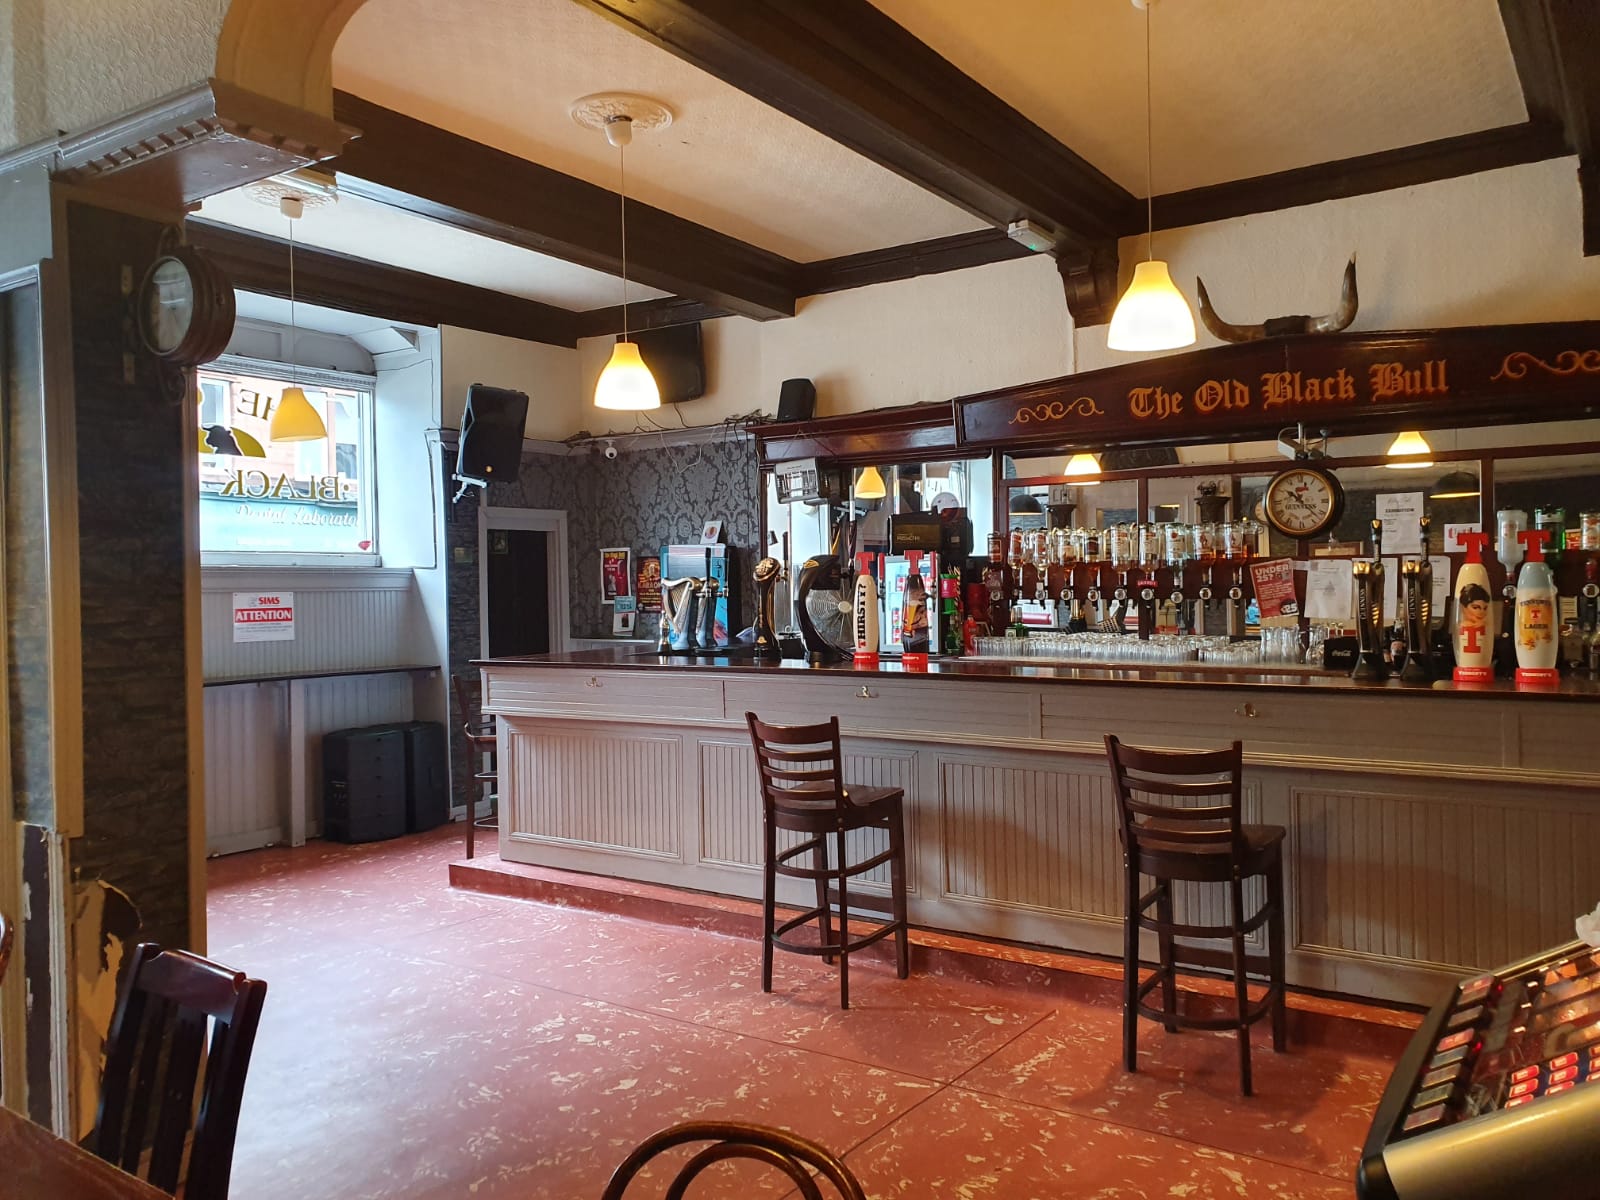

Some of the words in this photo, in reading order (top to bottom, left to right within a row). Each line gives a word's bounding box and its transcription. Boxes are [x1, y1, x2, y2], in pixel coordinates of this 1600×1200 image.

[1127, 386, 1184, 420] The
[1194, 379, 1250, 413] Old
[1260, 367, 1358, 410] Black
[1368, 359, 1449, 402] Bull
[1255, 563, 1290, 576] UNDER
[1256, 573, 1274, 583] 25?
[257, 596, 281, 605] SIMS
[1359, 588, 1367, 620] GUINNESS
[236, 610, 292, 621] ATTENTION
[857, 583, 867, 649] THIRSTY?
